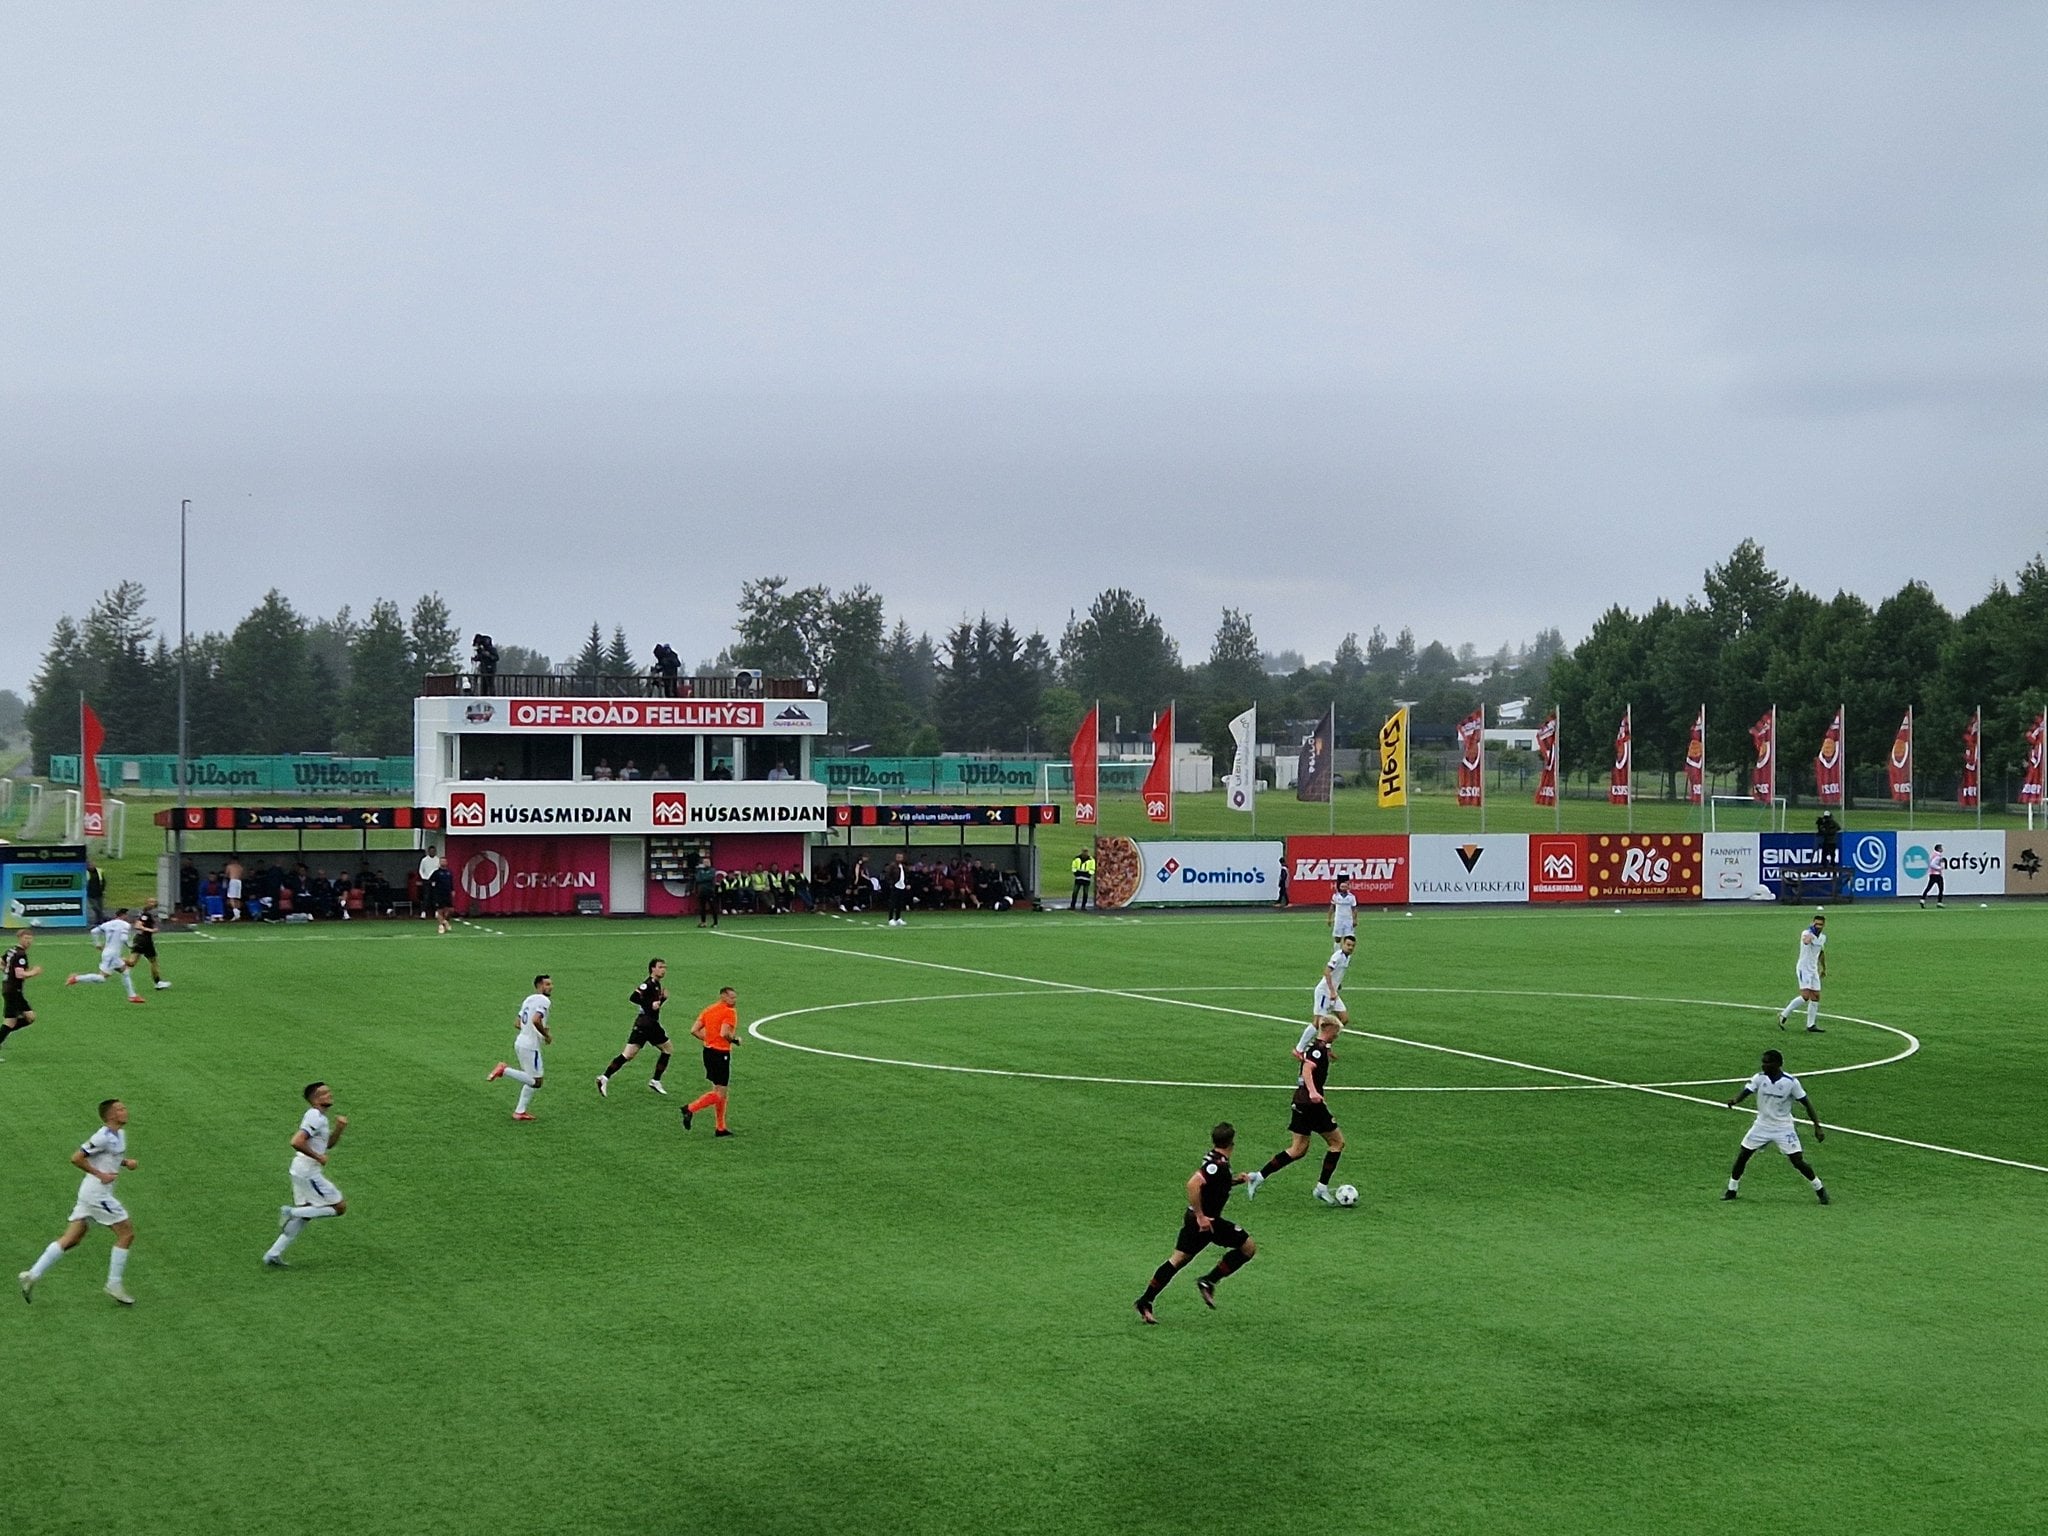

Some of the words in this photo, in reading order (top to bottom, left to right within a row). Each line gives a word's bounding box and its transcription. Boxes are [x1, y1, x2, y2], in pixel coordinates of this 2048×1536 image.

[517, 704, 639, 724] OFF-ROAD
[645, 703, 756, 725] FELLIHÝSI
[169, 762, 259, 786] Wilson
[293, 763, 380, 785] Wilson
[827, 765, 906, 785] Wilson
[957, 764, 1033, 785] Wilson
[1063, 764, 1136, 785] Wson
[490, 804, 632, 823] HÚSASMIÐJAN
[691, 804, 825, 822] HÚSASMIÐJAN
[1621, 847, 1670, 883] Rís
[1762, 848, 1840, 864] SINDI
[1182, 866, 1265, 884] Domino's
[1293, 858, 1397, 880] KATRIN
[514, 871, 596, 889] ORKAN
[1413, 880, 1451, 892] VÉLAR
[1454, 882, 1463, 892] &
[1466, 881, 1525, 892] VERKFÆRI
